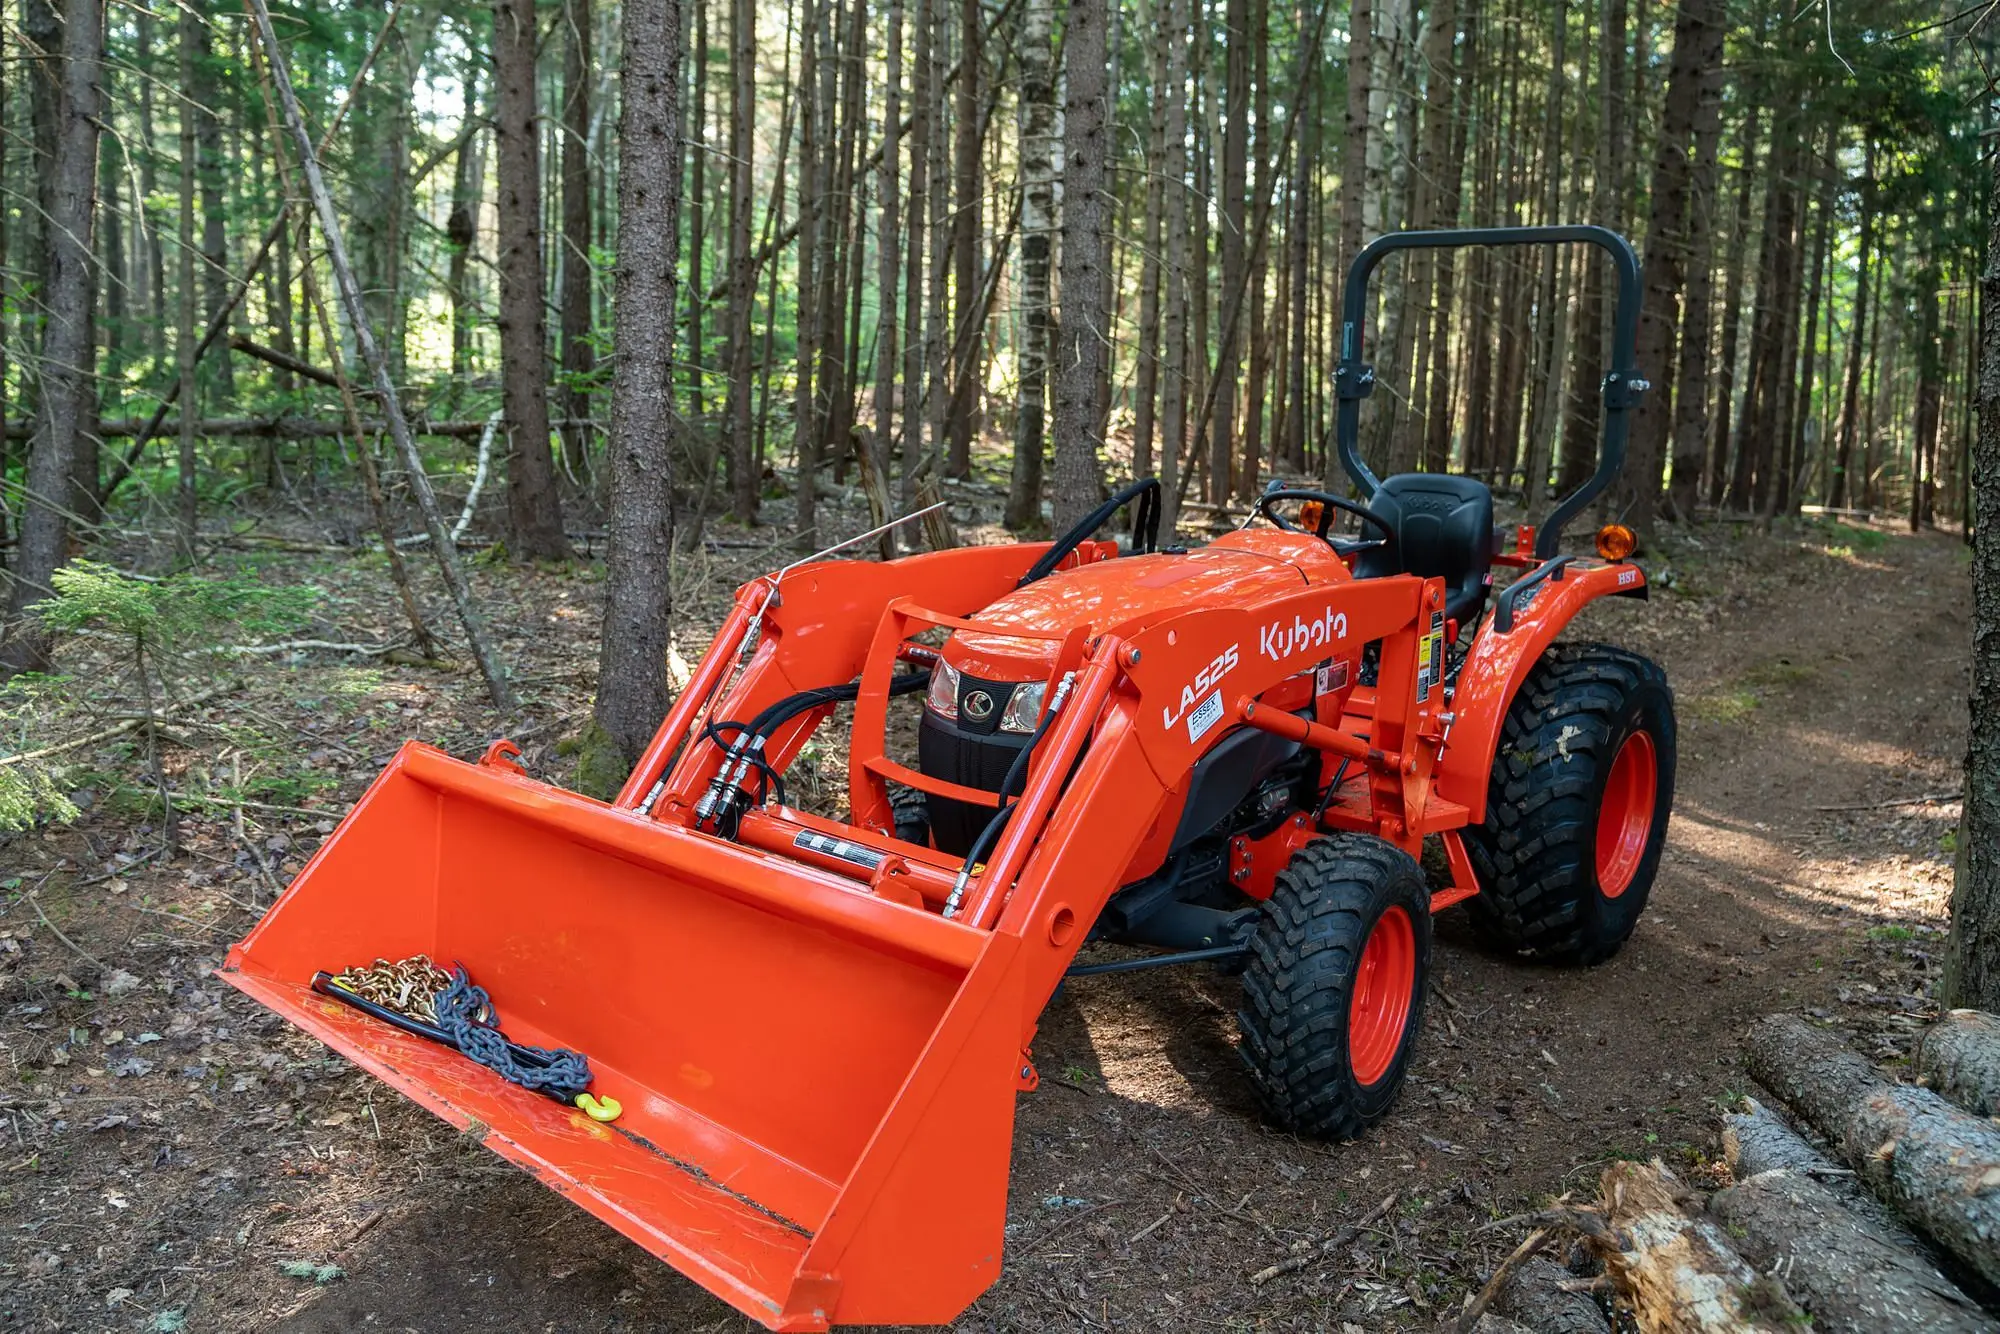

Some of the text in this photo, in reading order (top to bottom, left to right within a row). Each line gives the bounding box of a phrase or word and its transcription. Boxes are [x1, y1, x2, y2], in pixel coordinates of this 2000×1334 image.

[1618, 570, 1636, 585] HST
[1260, 605, 1347, 661] Kubota
[1163, 642, 1239, 730] LA525
[1192, 695, 1217, 726] ESSEX
